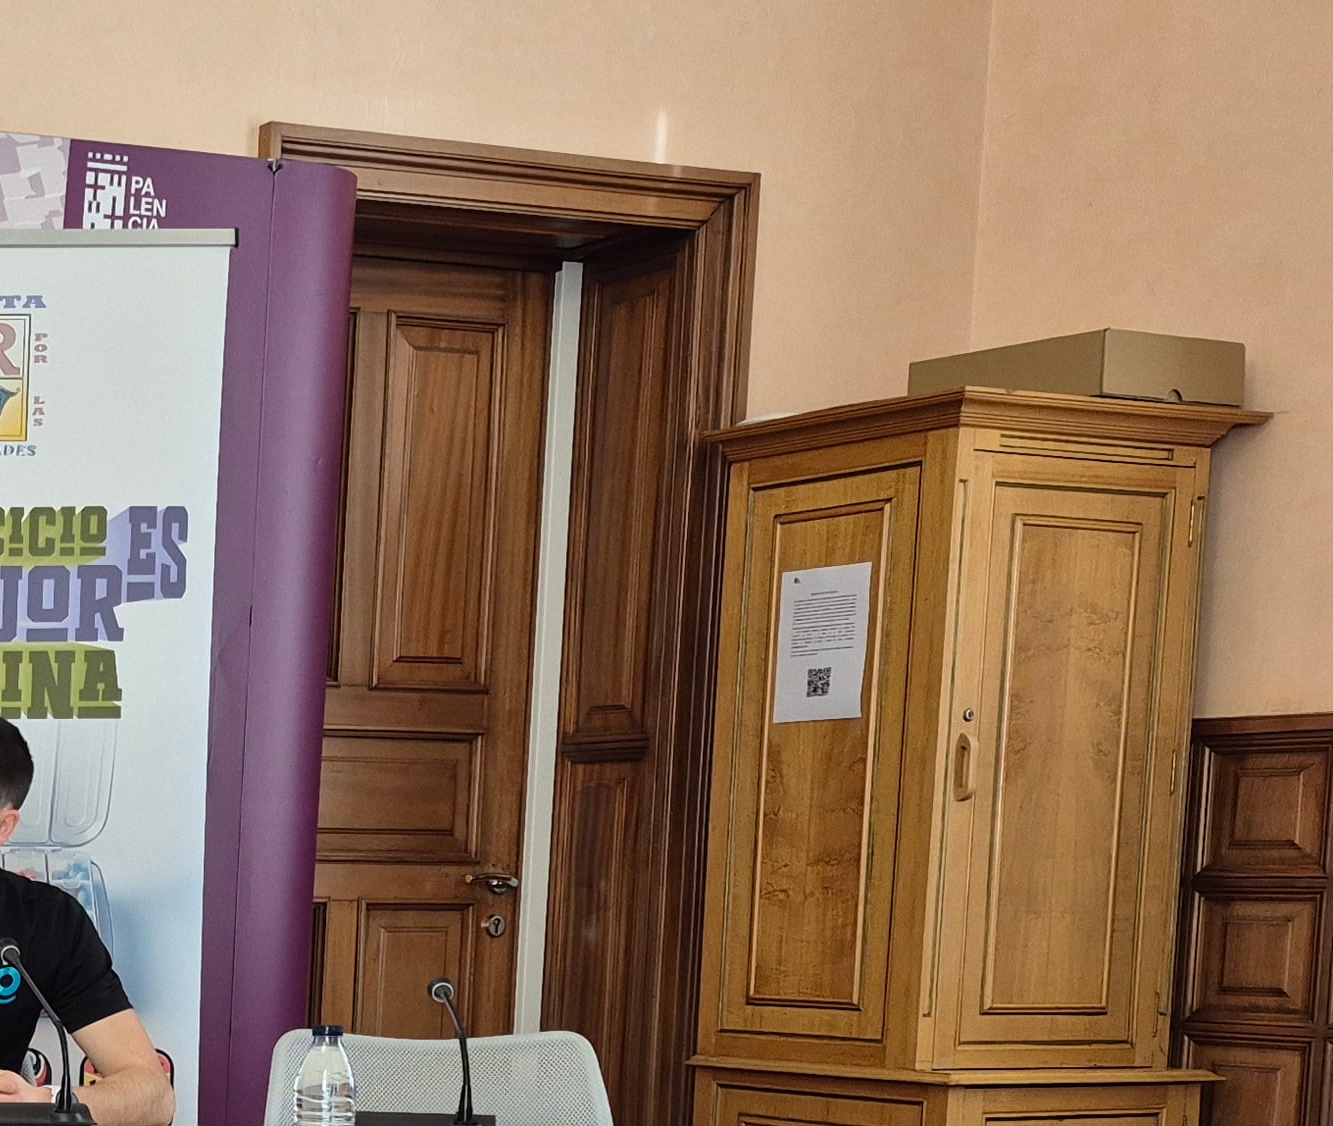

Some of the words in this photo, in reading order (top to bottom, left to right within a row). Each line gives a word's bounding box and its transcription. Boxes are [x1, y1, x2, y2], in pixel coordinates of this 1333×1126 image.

[131, 176, 155, 196] PA
[129, 196, 166, 217] LEN
[34, 333, 48, 363] POR
[32, 396, 45, 427] LAS
[126, 506, 189, 599] ES
